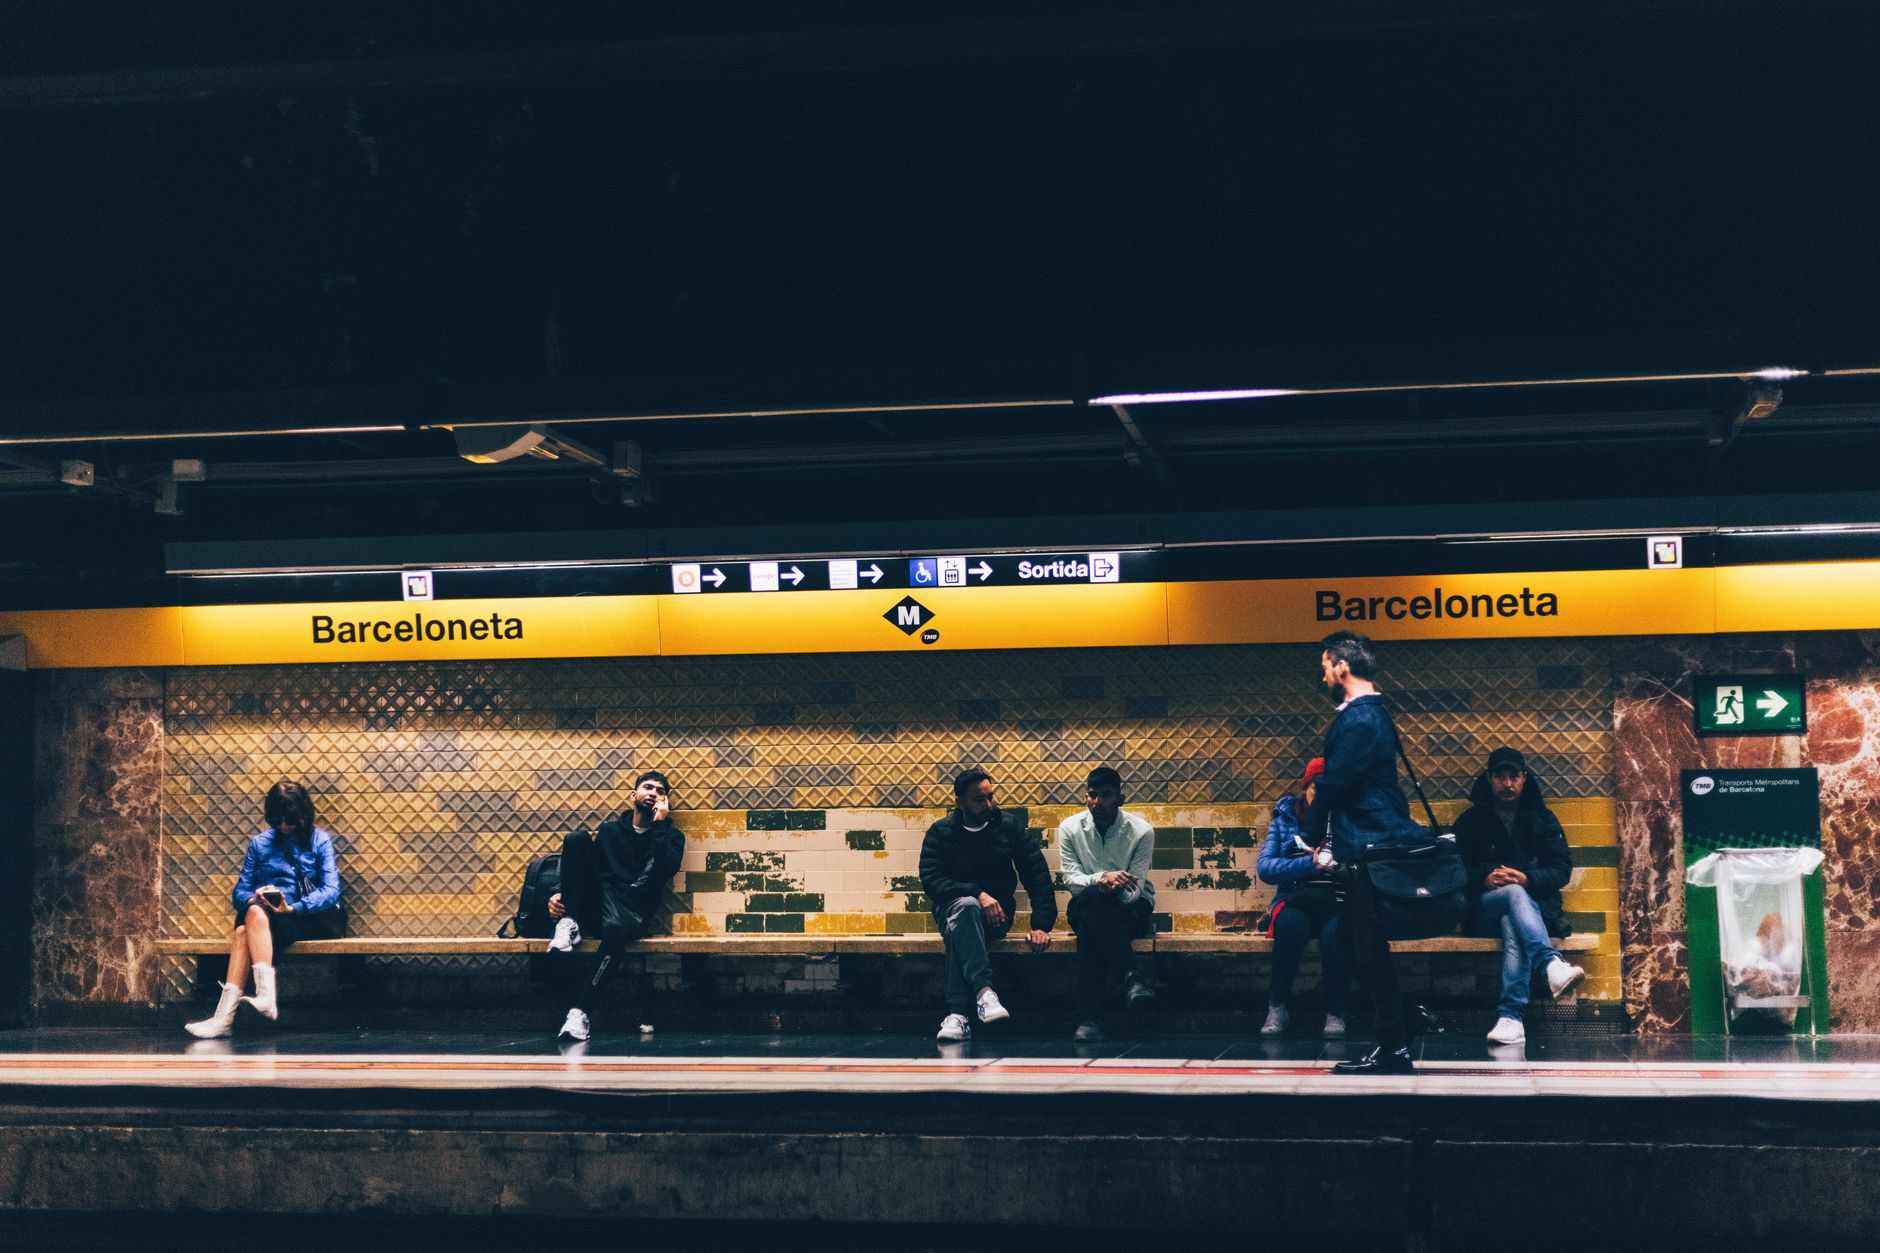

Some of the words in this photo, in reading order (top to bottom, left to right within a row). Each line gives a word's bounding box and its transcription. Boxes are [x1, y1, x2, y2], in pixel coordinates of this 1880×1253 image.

[1018, 560, 1088, 579] Sortida
[1315, 587, 1558, 622] Barceloneta
[897, 605, 920, 626] M
[312, 613, 523, 643] Barceloneta
[1755, 778, 1800, 786] Metropolitans
